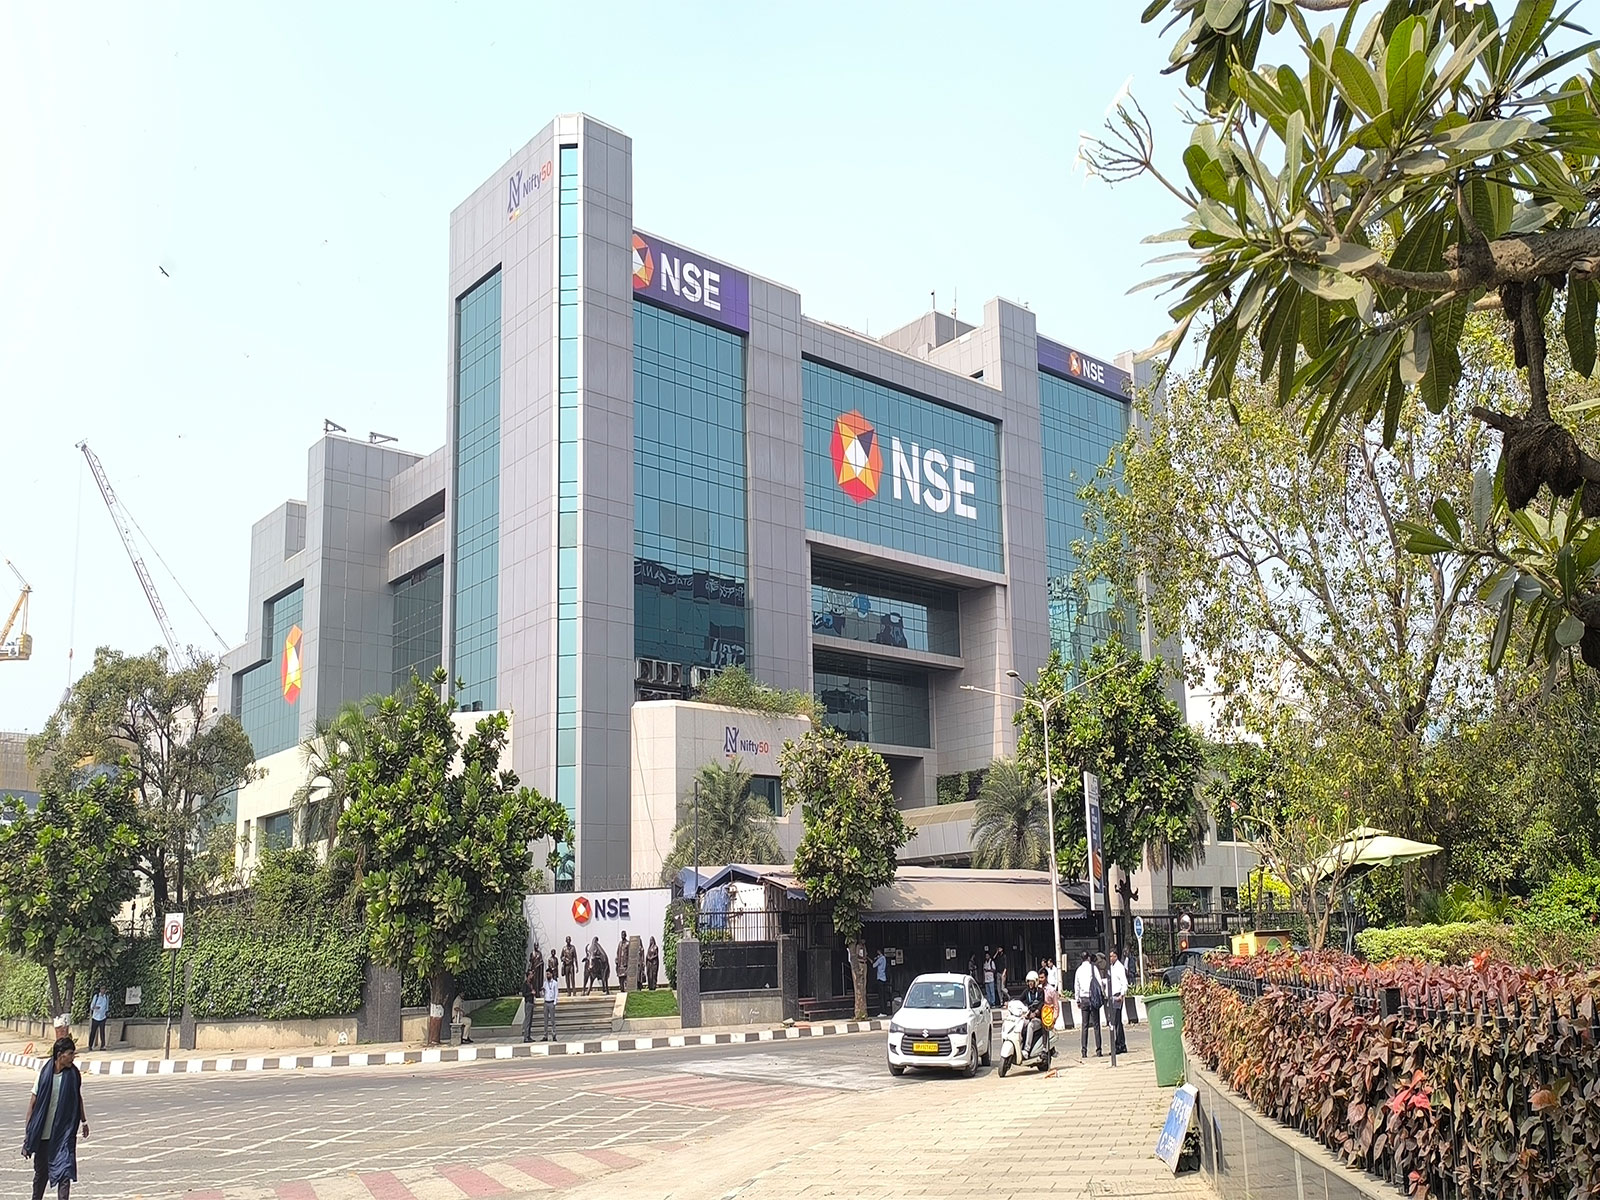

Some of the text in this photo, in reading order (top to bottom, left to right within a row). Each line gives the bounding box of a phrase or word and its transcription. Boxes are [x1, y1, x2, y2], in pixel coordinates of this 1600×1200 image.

[523, 161, 552, 198] Nifty50
[660, 252, 721, 312] NSE
[1082, 358, 1105, 384] NSE
[892, 436, 977, 520] NSE
[740, 739, 769, 755] Nifty50
[594, 897, 629, 919] NSE
